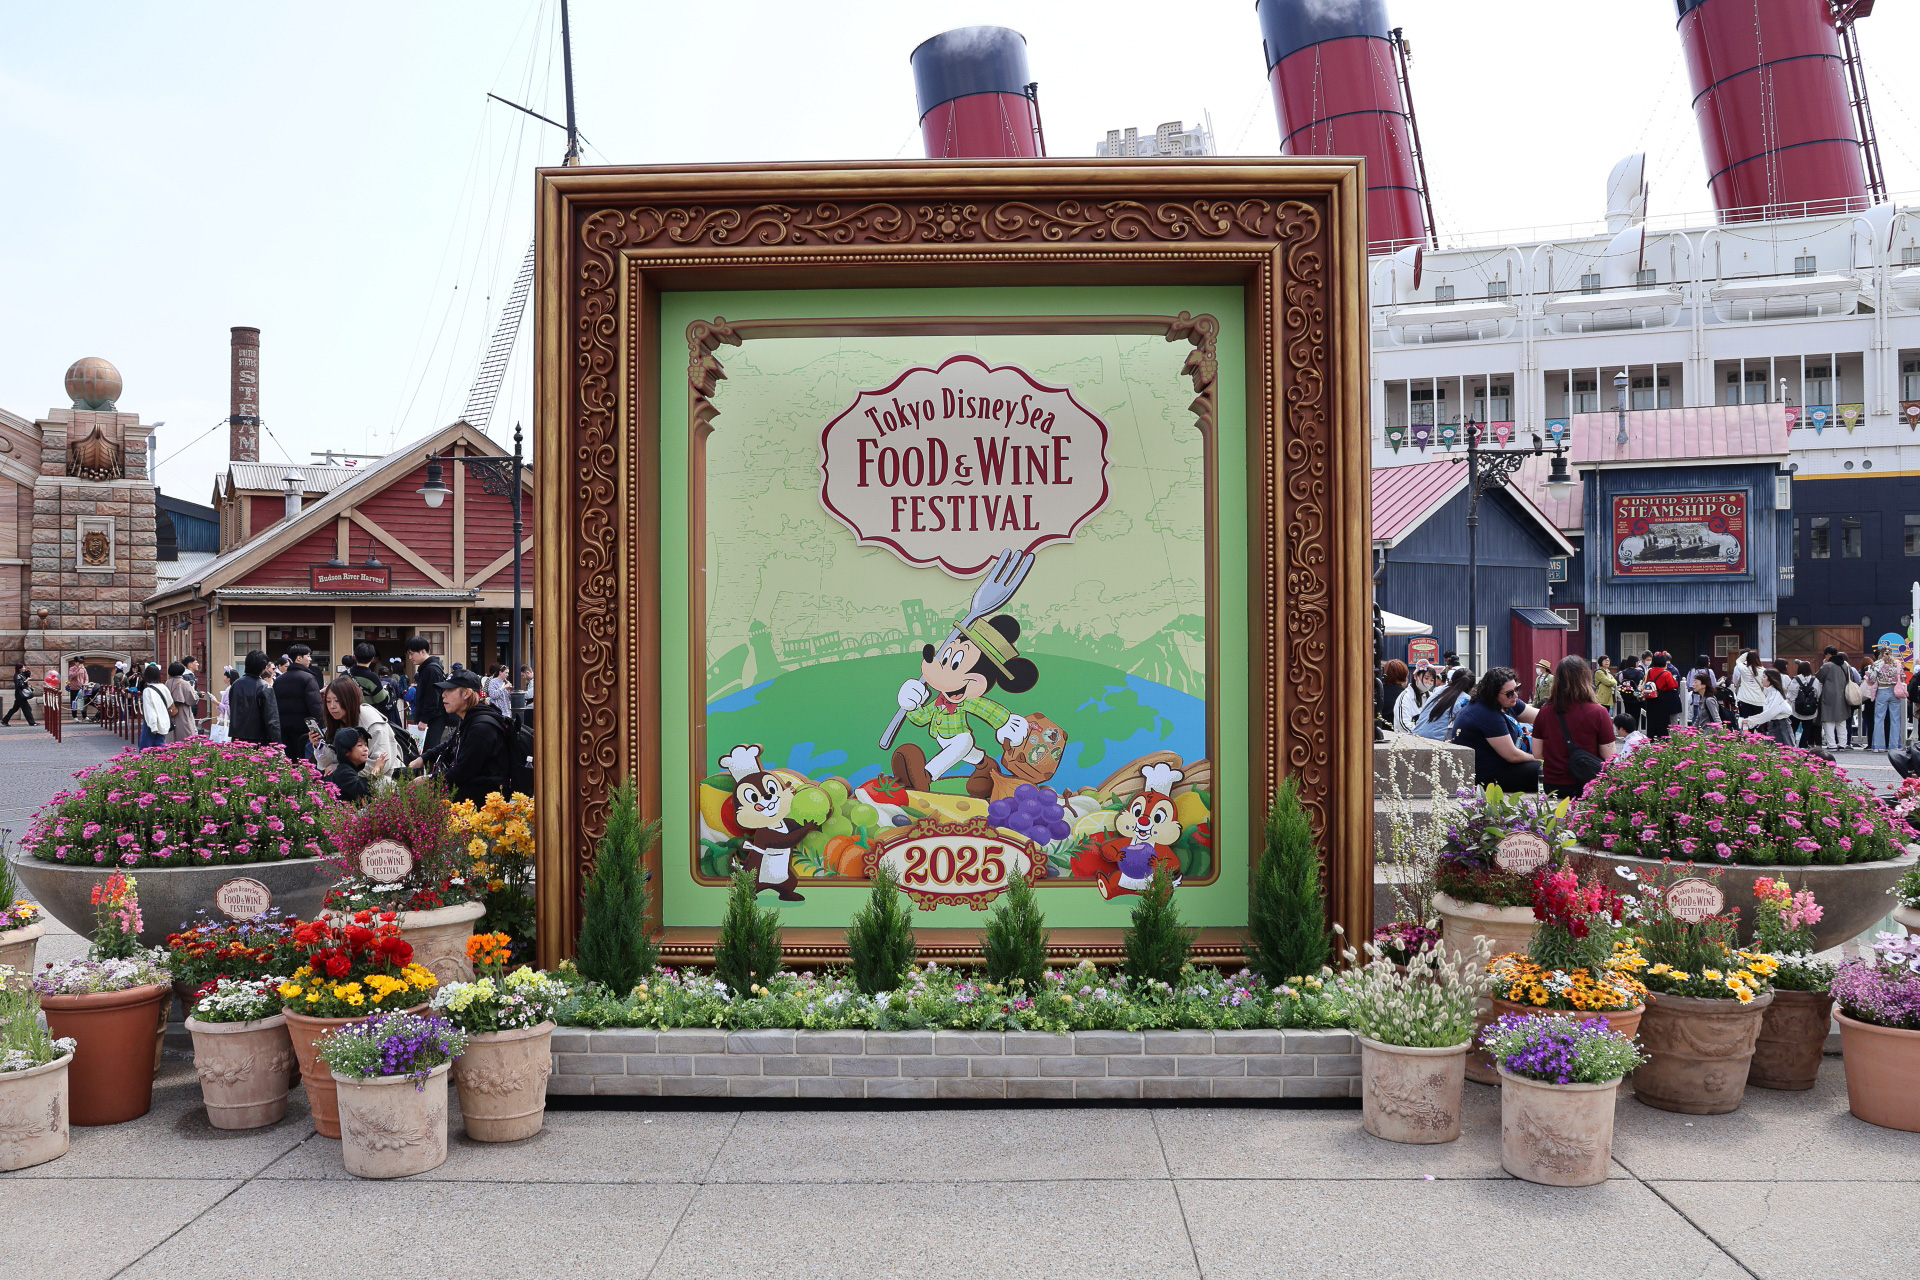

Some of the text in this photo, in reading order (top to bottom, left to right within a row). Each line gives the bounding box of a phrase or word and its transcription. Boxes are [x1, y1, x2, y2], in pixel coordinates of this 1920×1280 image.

[864, 387, 1056, 437] Tokyo DisneySea
[856, 435, 1074, 488] FOOD & WINE
[1631, 496, 1726, 505] UNITED STATES
[890, 494, 1040, 533] FESTIVAL
[1618, 504, 1716, 518] STEAMSHIP
[318, 574, 342, 583] Hudson
[343, 572, 360, 580] River
[360, 573, 385, 584] Harvest
[1523, 847, 1543, 858] WINE
[366, 856, 383, 867] FOOD
[387, 855, 405, 866] WINE
[903, 845, 1007, 886] 2025
[1508, 858, 1536, 867] FESTIVAL
[372, 866, 400, 875] FESTIVAL
[224, 893, 240, 904] FOOD
[244, 895, 262, 905] WINE
[1696, 895, 1716, 907] WINE
[230, 905, 257, 913] FESTIVAL
[1680, 907, 1709, 916] FESTIVAL
